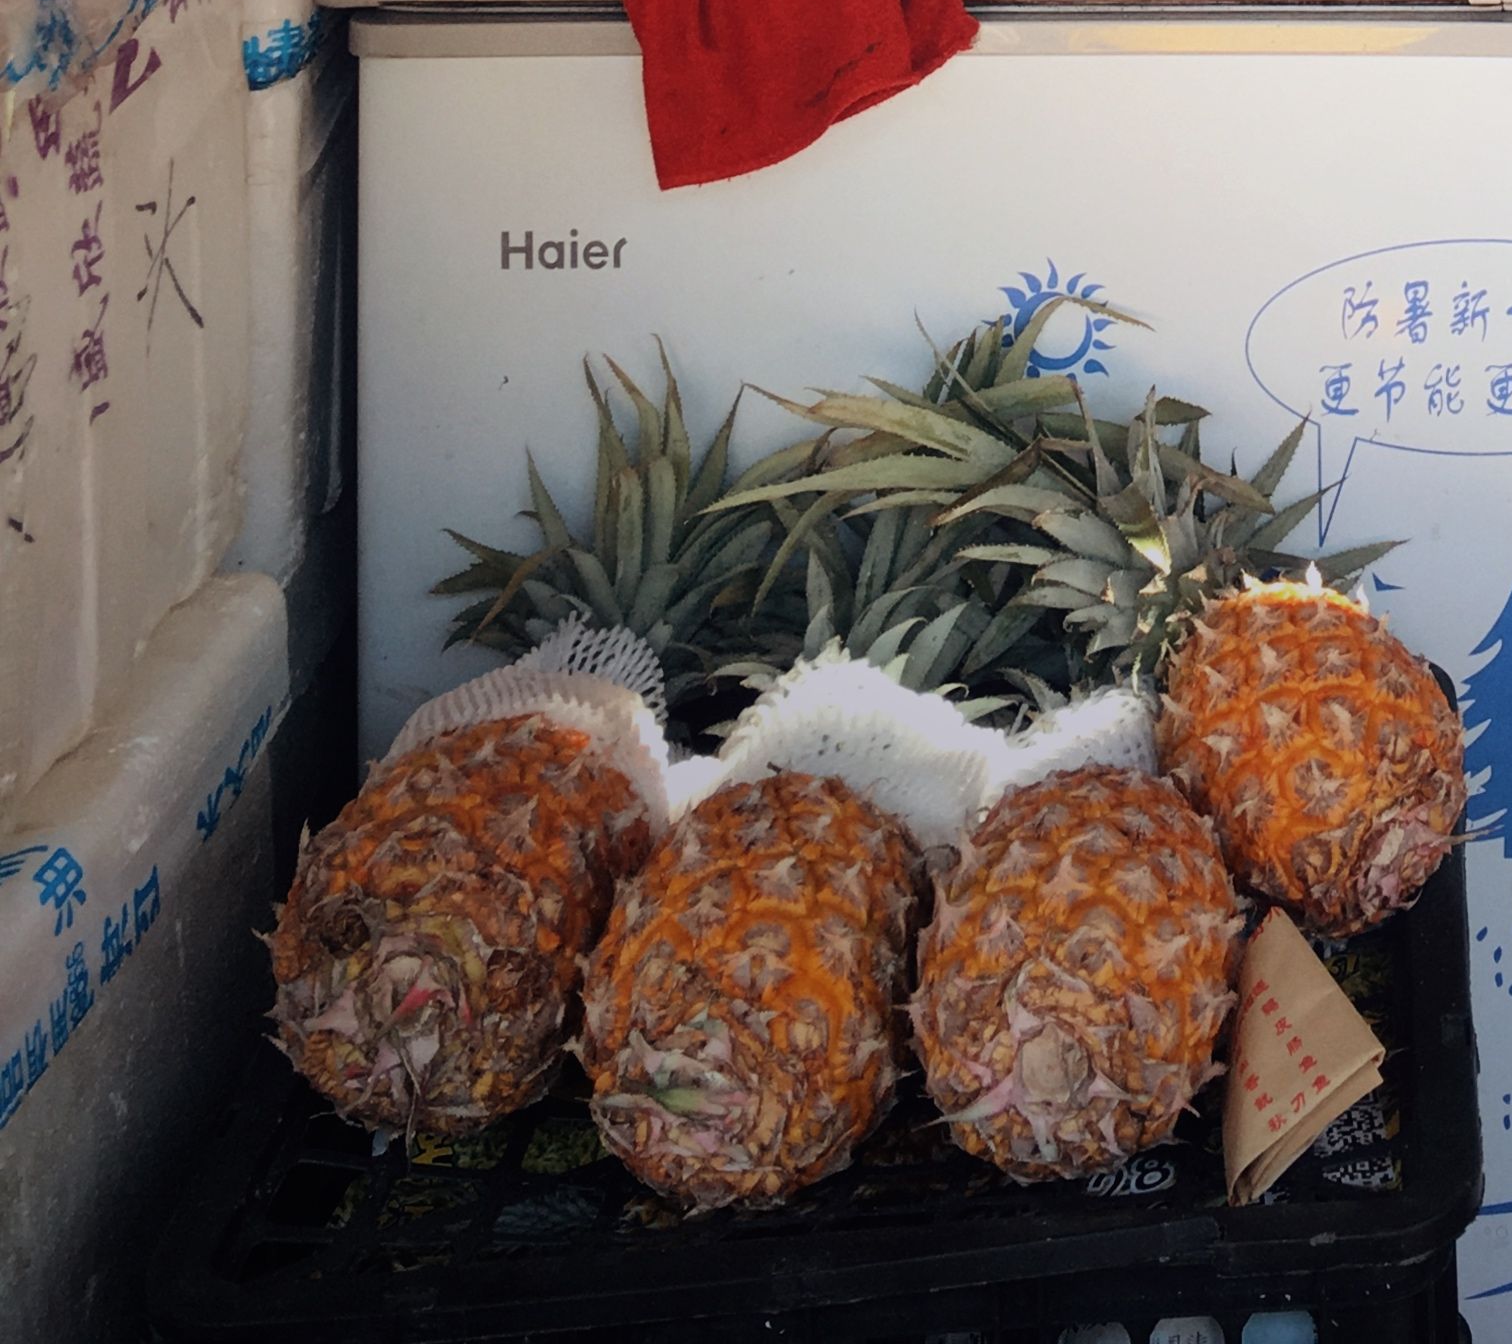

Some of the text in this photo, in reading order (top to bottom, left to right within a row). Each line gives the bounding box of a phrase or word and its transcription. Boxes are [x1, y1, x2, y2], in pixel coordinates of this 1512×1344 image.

[501, 228, 628, 269] Haier
[1268, 1074, 1332, 1133] 秋刀鱼
